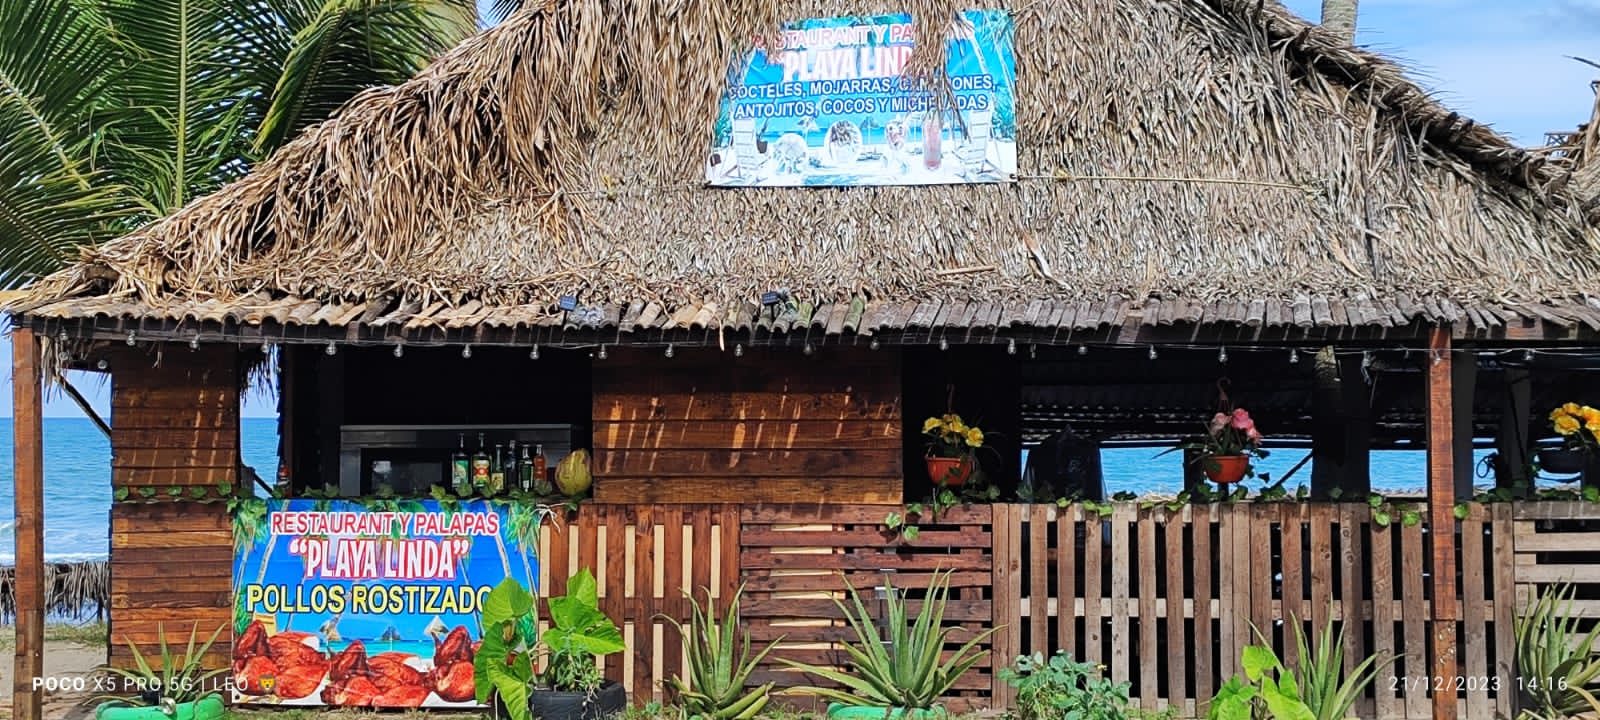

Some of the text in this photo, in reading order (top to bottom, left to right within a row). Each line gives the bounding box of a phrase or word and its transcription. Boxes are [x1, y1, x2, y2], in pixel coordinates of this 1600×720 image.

[752, 24, 871, 50] STAURANT
[873, 24, 888, 43] Y
[730, 74, 997, 99] COCTELES, MOJARRAS, CMONES,
[734, 94, 988, 119] ANTOJITOS, COCOS Y MICHEDAS
[271, 512, 499, 535] RESTAURANT Y PALAPAS
[247, 584, 492, 614] POLLOS ROSTIZADO
